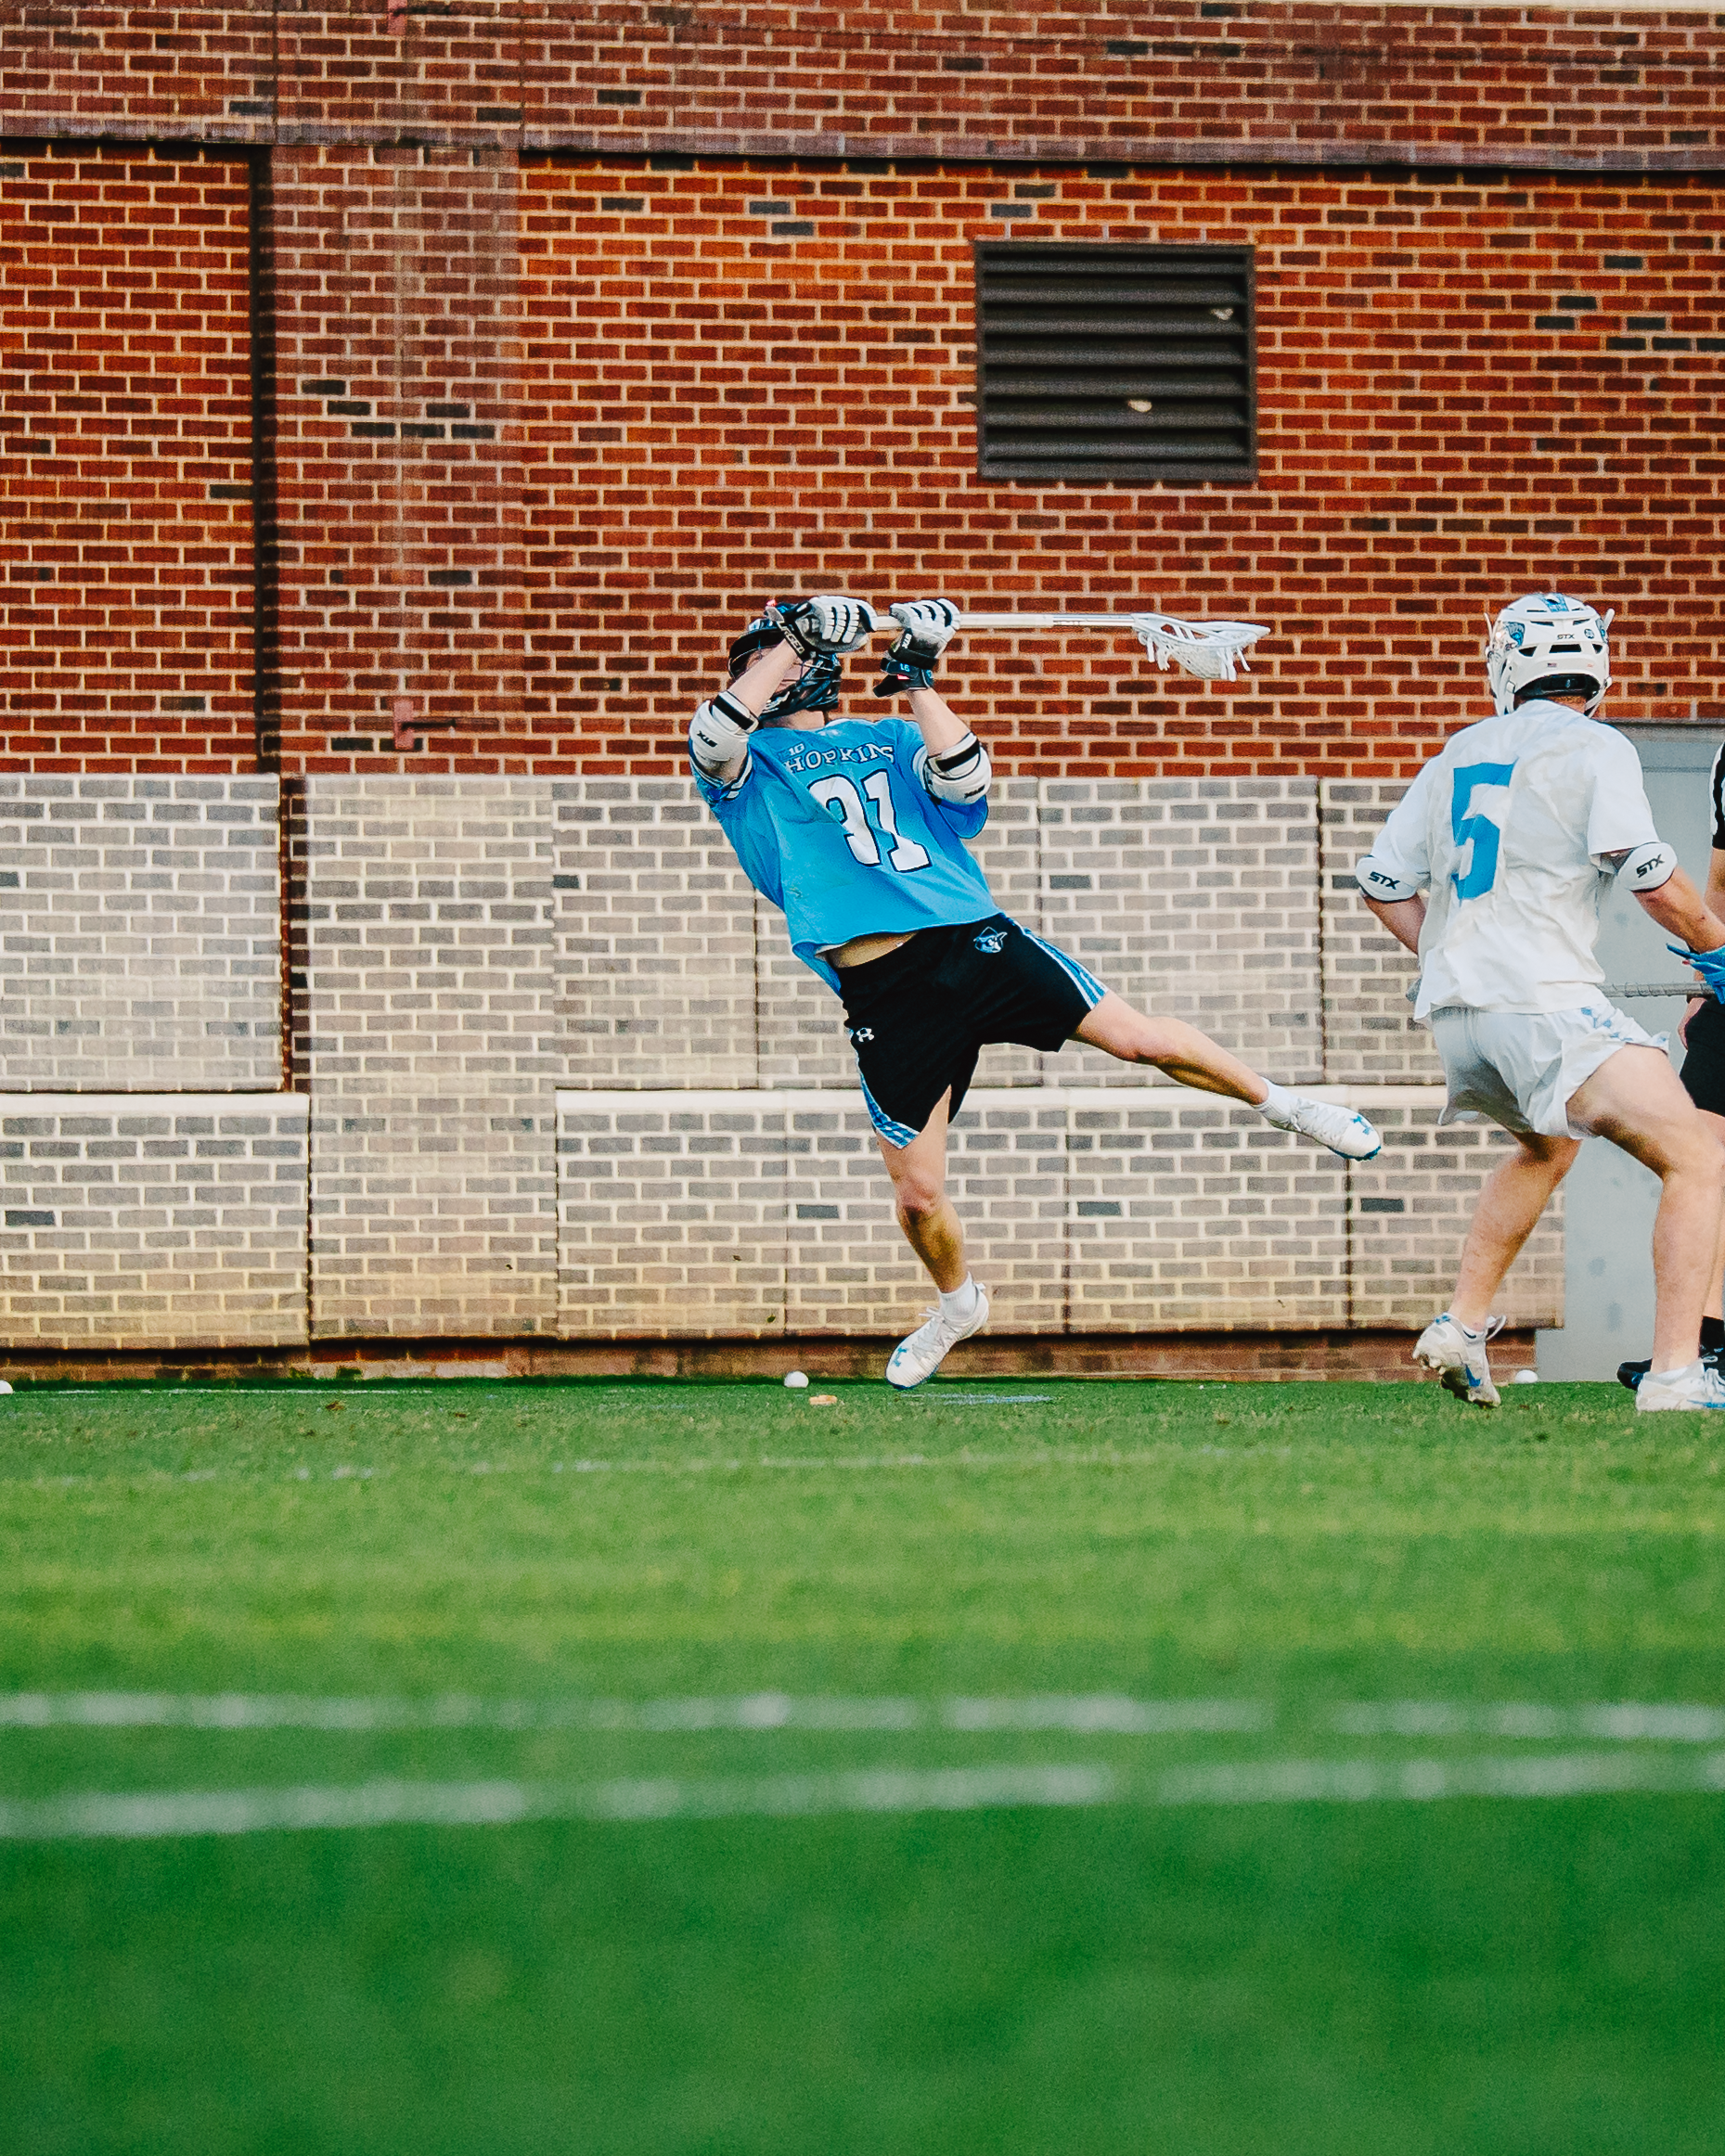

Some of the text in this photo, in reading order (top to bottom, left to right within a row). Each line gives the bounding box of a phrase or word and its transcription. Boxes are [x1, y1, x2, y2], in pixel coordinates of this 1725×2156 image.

[783, 743, 895, 773] HOPKINS
[1451, 758, 1519, 904] 5
[1636, 853, 1665, 879] STX
[1368, 871, 1400, 890] STX
